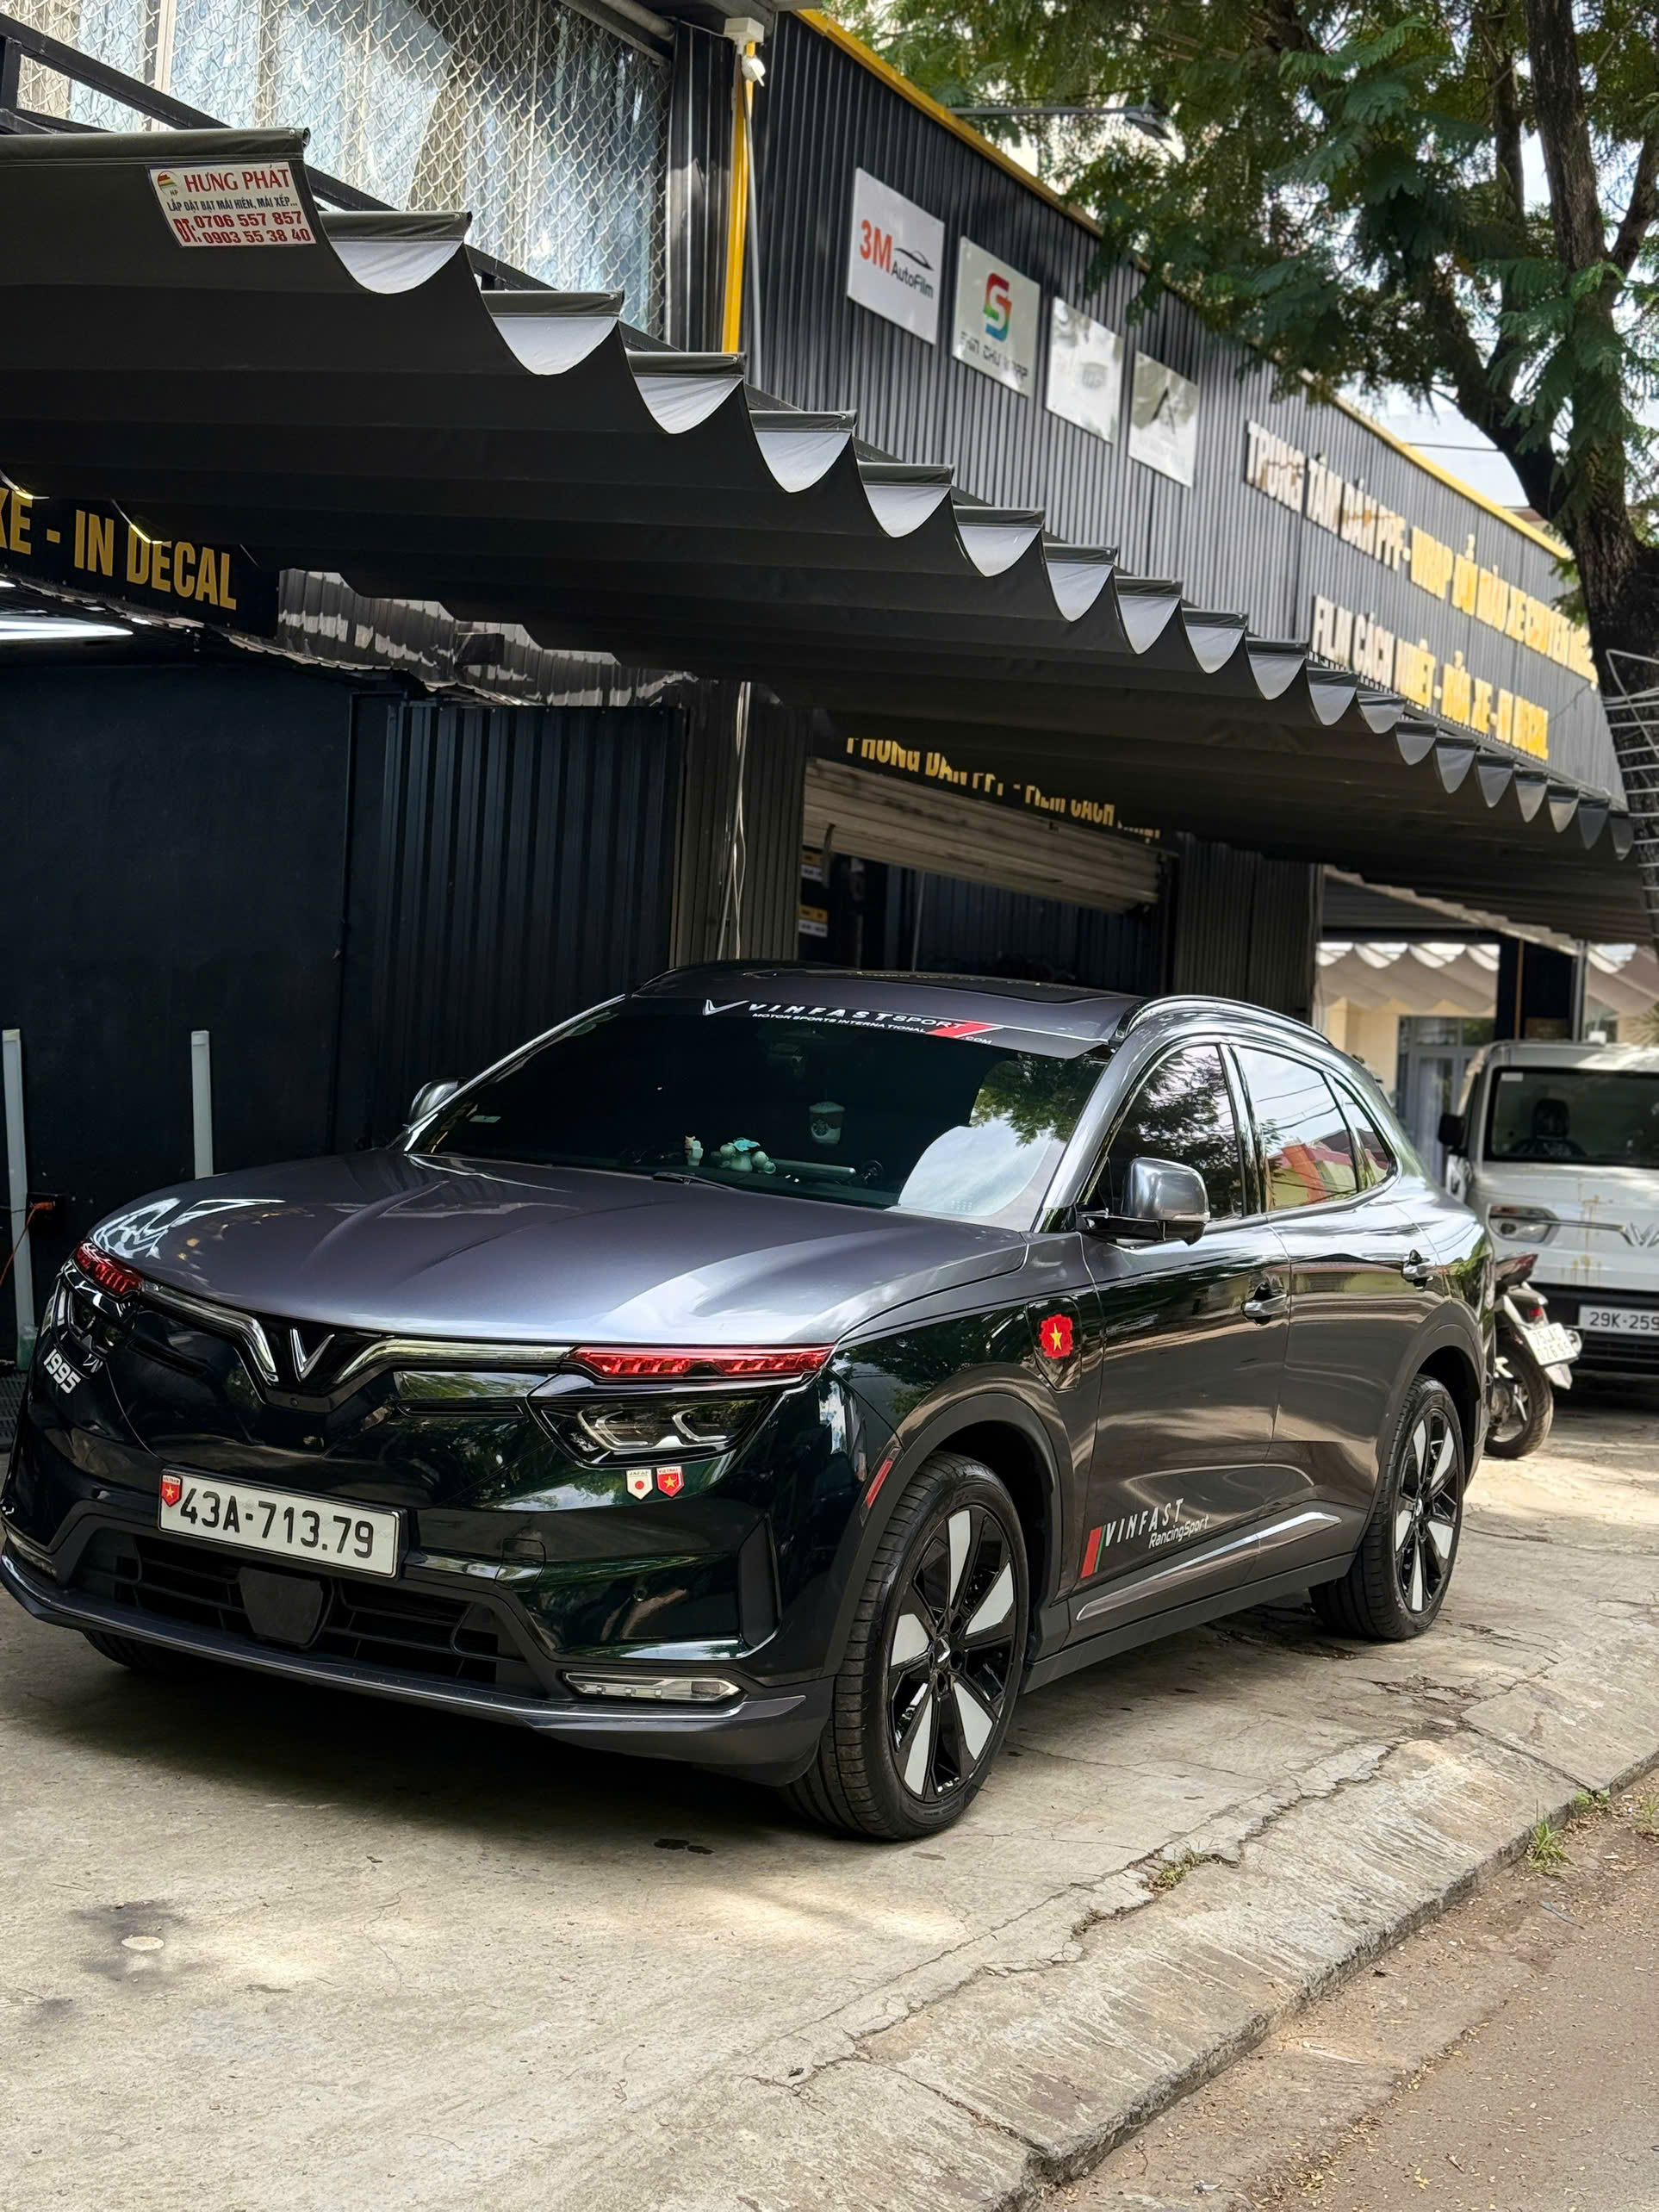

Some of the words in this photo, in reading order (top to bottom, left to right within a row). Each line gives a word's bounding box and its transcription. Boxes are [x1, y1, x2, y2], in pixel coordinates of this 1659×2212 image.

[183, 172, 239, 193] HƯNG
[242, 165, 290, 190] PHÁT
[194, 214, 235, 228] 0706
[237, 213, 266, 227] 557
[271, 211, 301, 225] 857
[216, 197, 233, 210] MÁI
[257, 196, 274, 208] MÁI
[202, 231, 241, 244] 0903
[242, 230, 264, 243] 55
[266, 229, 288, 242] 38
[291, 228, 311, 241] 40
[860, 219, 892, 273] 3M
[891, 260, 934, 300] AutoFilm
[74, 509, 115, 577] IN
[126, 522, 237, 611] DECAL
[837, 1019, 927, 1034] INTERNATIONAL
[43, 1348, 81, 1394] 1995
[180, 1488, 374, 1559] 43A-713.79
[1105, 1498, 1184, 1547] VINFAST
